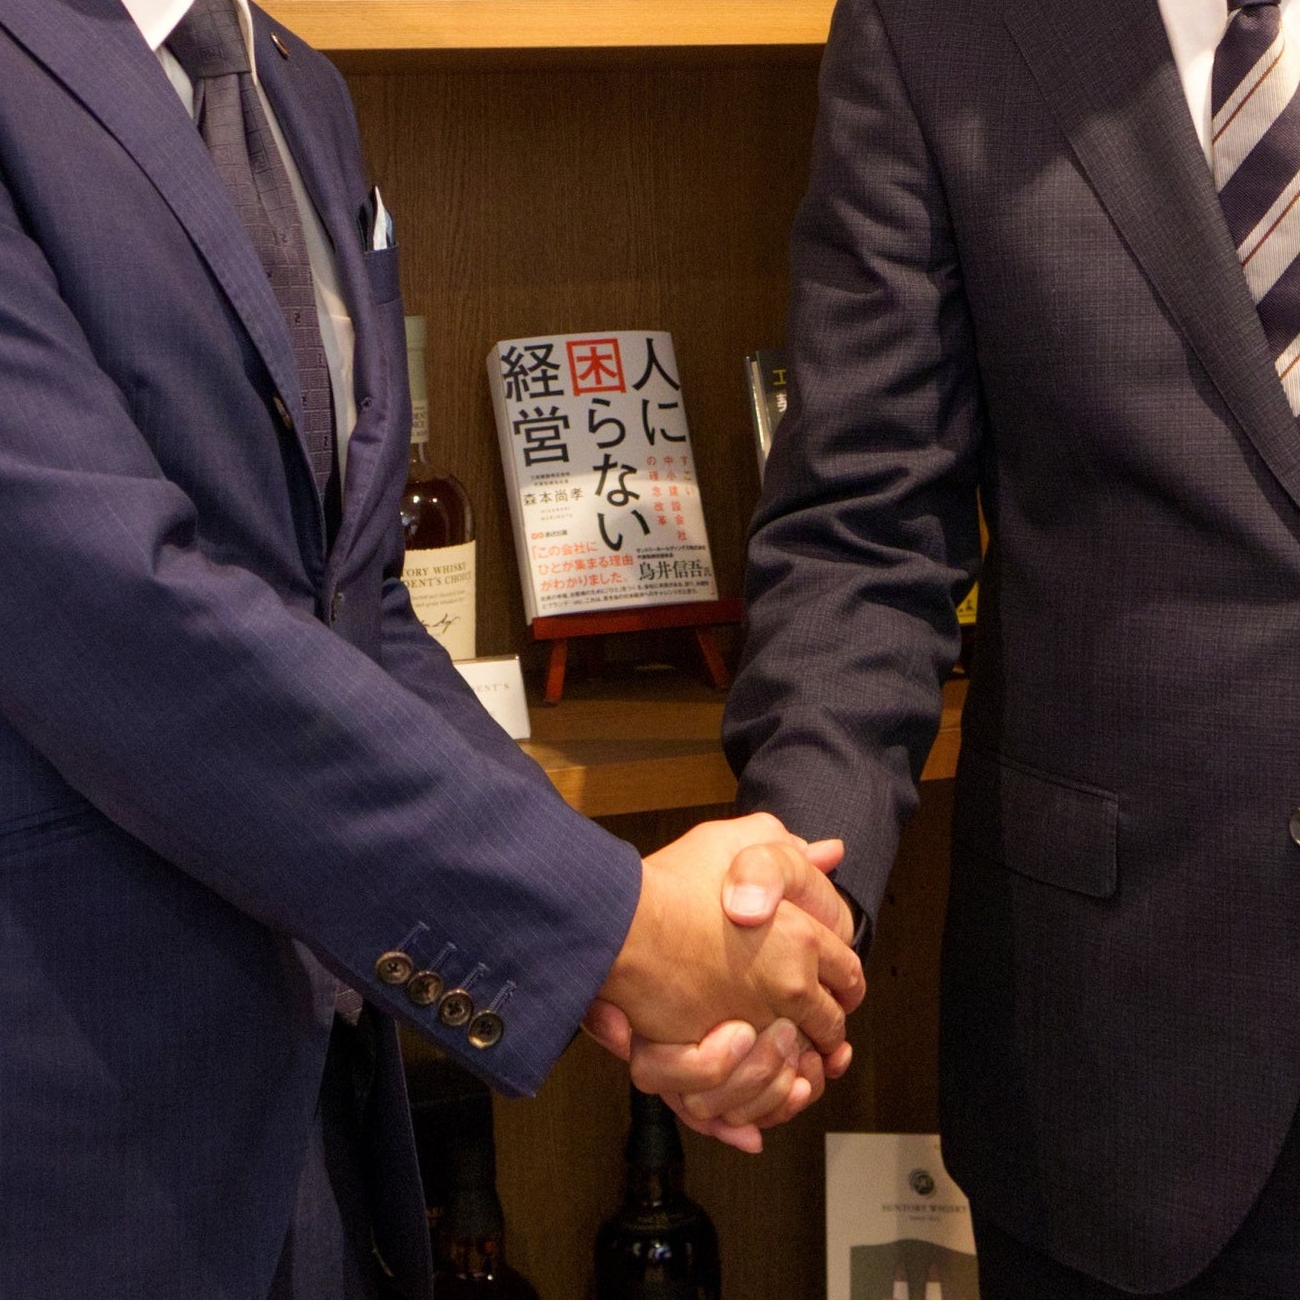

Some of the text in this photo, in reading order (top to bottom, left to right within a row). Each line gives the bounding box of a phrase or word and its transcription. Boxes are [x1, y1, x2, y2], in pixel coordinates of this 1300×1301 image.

[633, 337, 686, 446] 人に
[501, 343, 570, 467] 経営
[566, 338, 650, 552] 困らない
[524, 488, 584, 506] 森本尚孝
[401, 567, 428, 578] TORY
[538, 554, 634, 576] ひとが集まる理由
[403, 577, 442, 589] DENT'S
